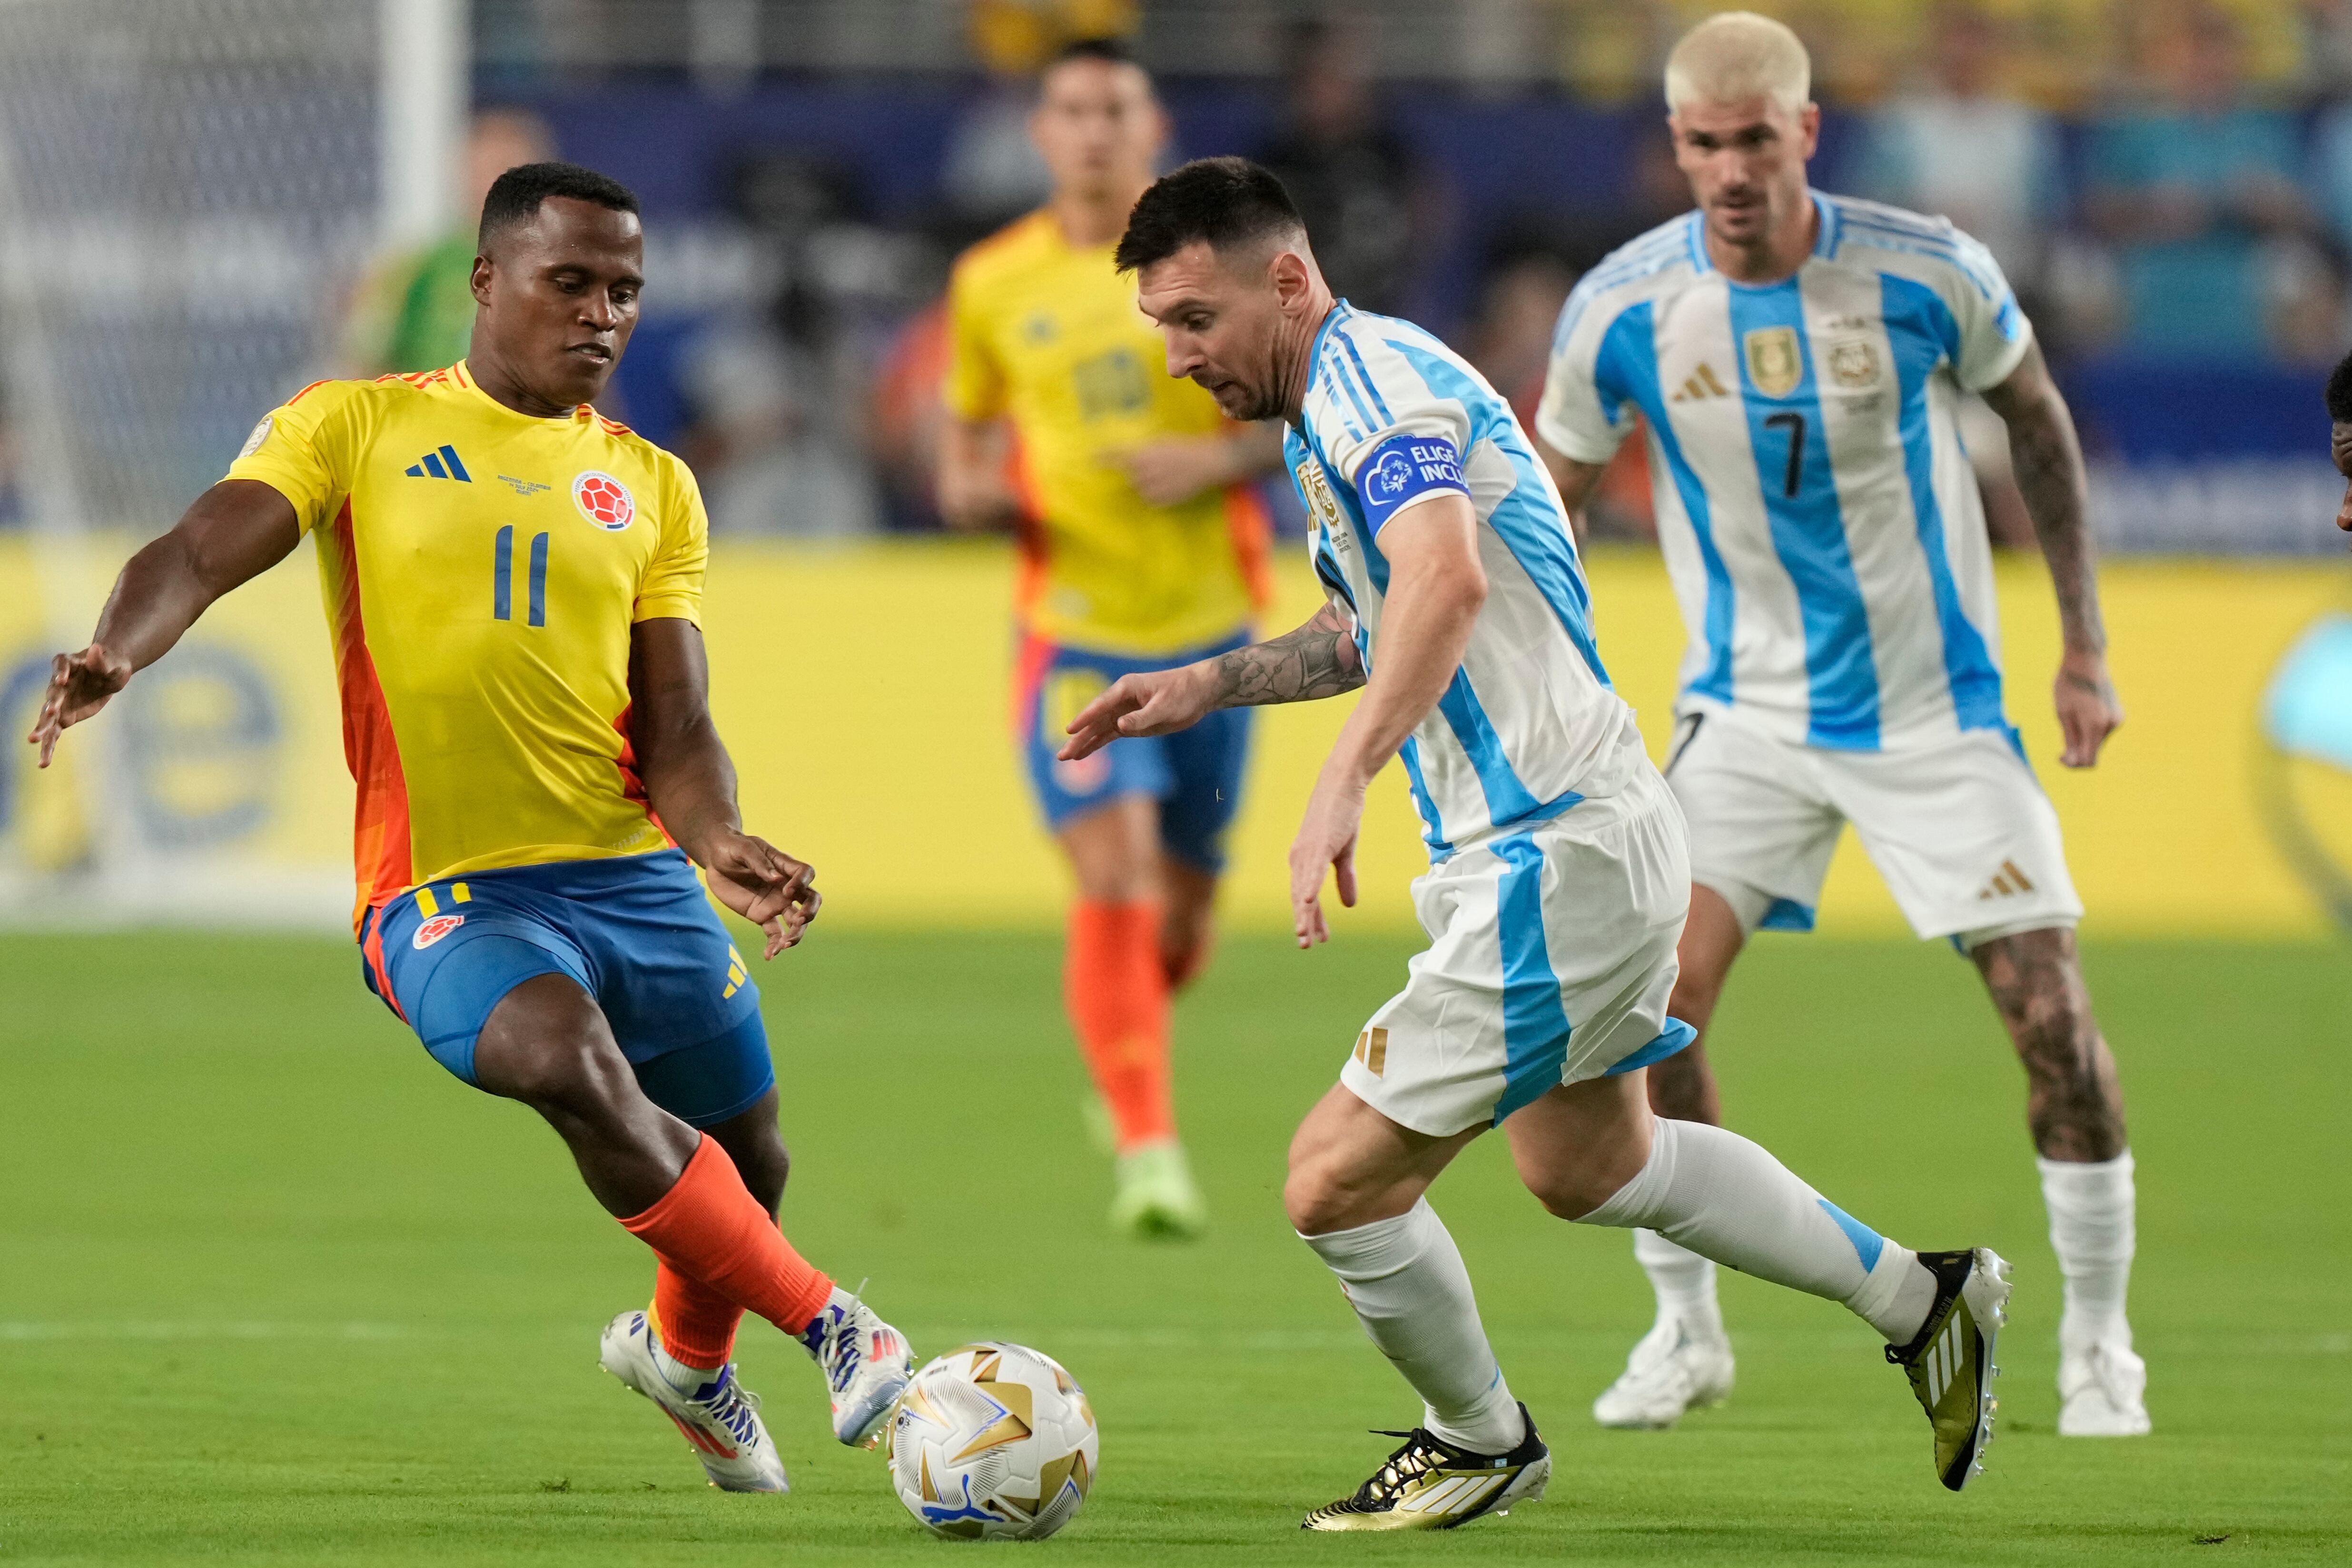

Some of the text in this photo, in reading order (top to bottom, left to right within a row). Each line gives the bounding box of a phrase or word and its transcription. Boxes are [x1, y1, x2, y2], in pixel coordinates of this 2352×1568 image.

[1412, 445, 1458, 467] ELIGE
[1765, 412, 1806, 498] 7
[497, 475, 522, 484] ARGENTINA
[527, 482, 551, 490] COLOMBIA
[494, 525, 549, 627] 11
